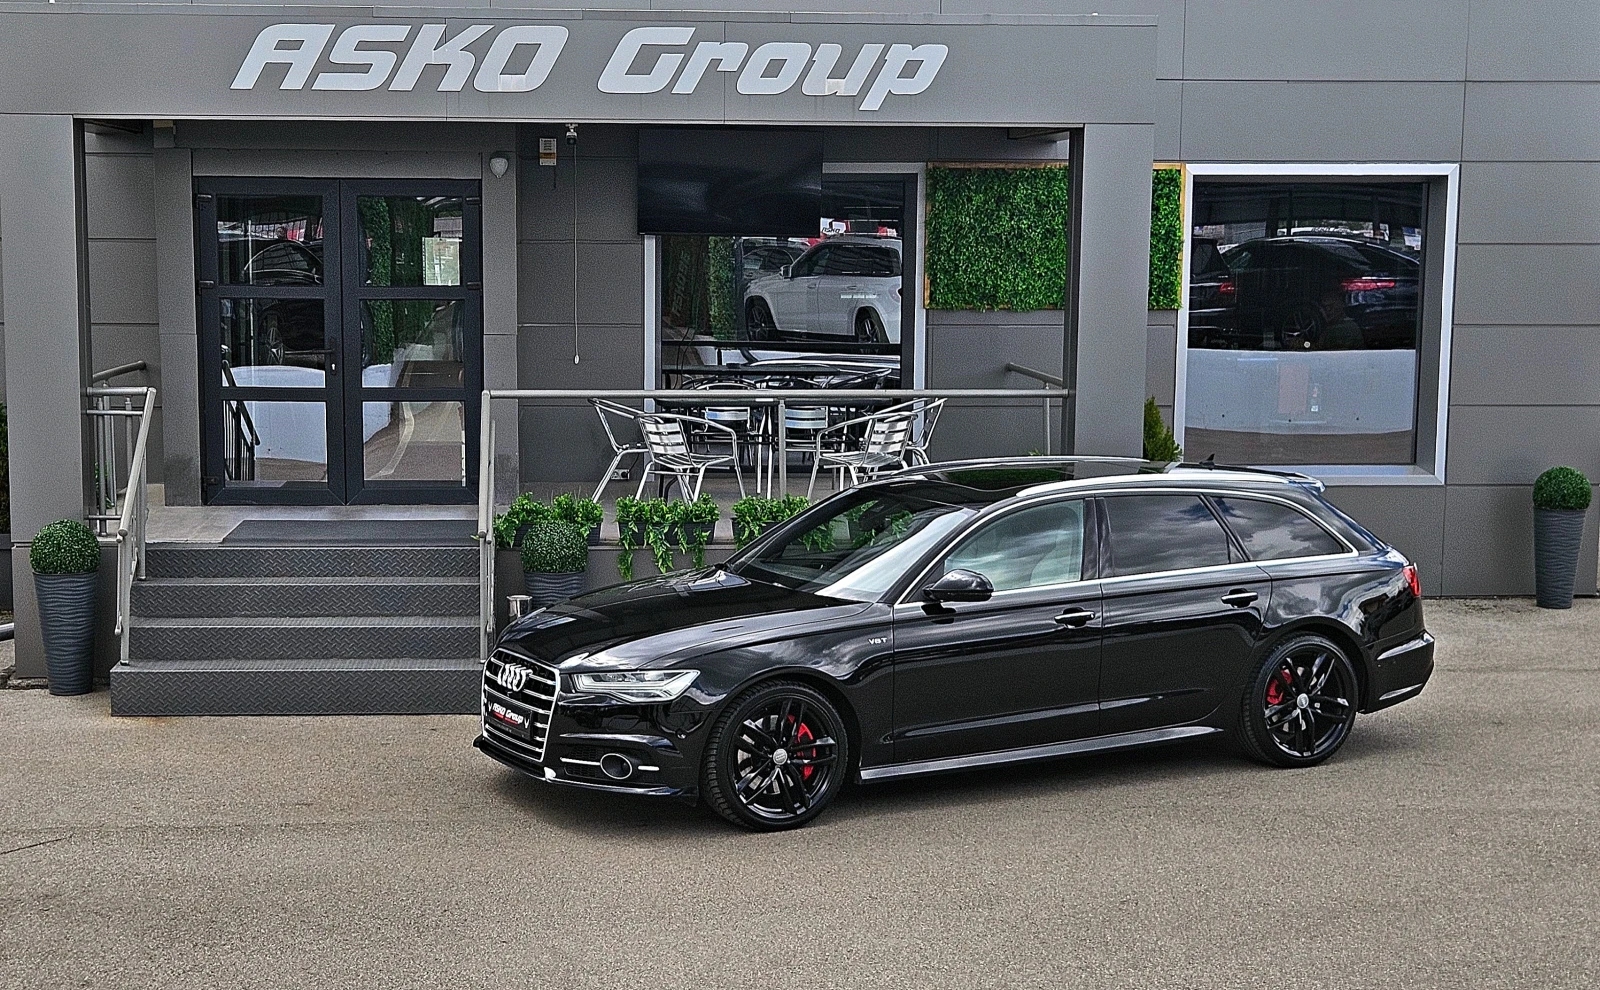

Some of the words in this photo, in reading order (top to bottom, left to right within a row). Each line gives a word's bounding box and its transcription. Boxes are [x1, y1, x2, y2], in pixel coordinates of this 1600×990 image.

[231, 24, 569, 92] ASKO
[597, 26, 949, 111] Group
[492, 702, 506, 716] ASKO
[505, 709, 524, 724] Group
